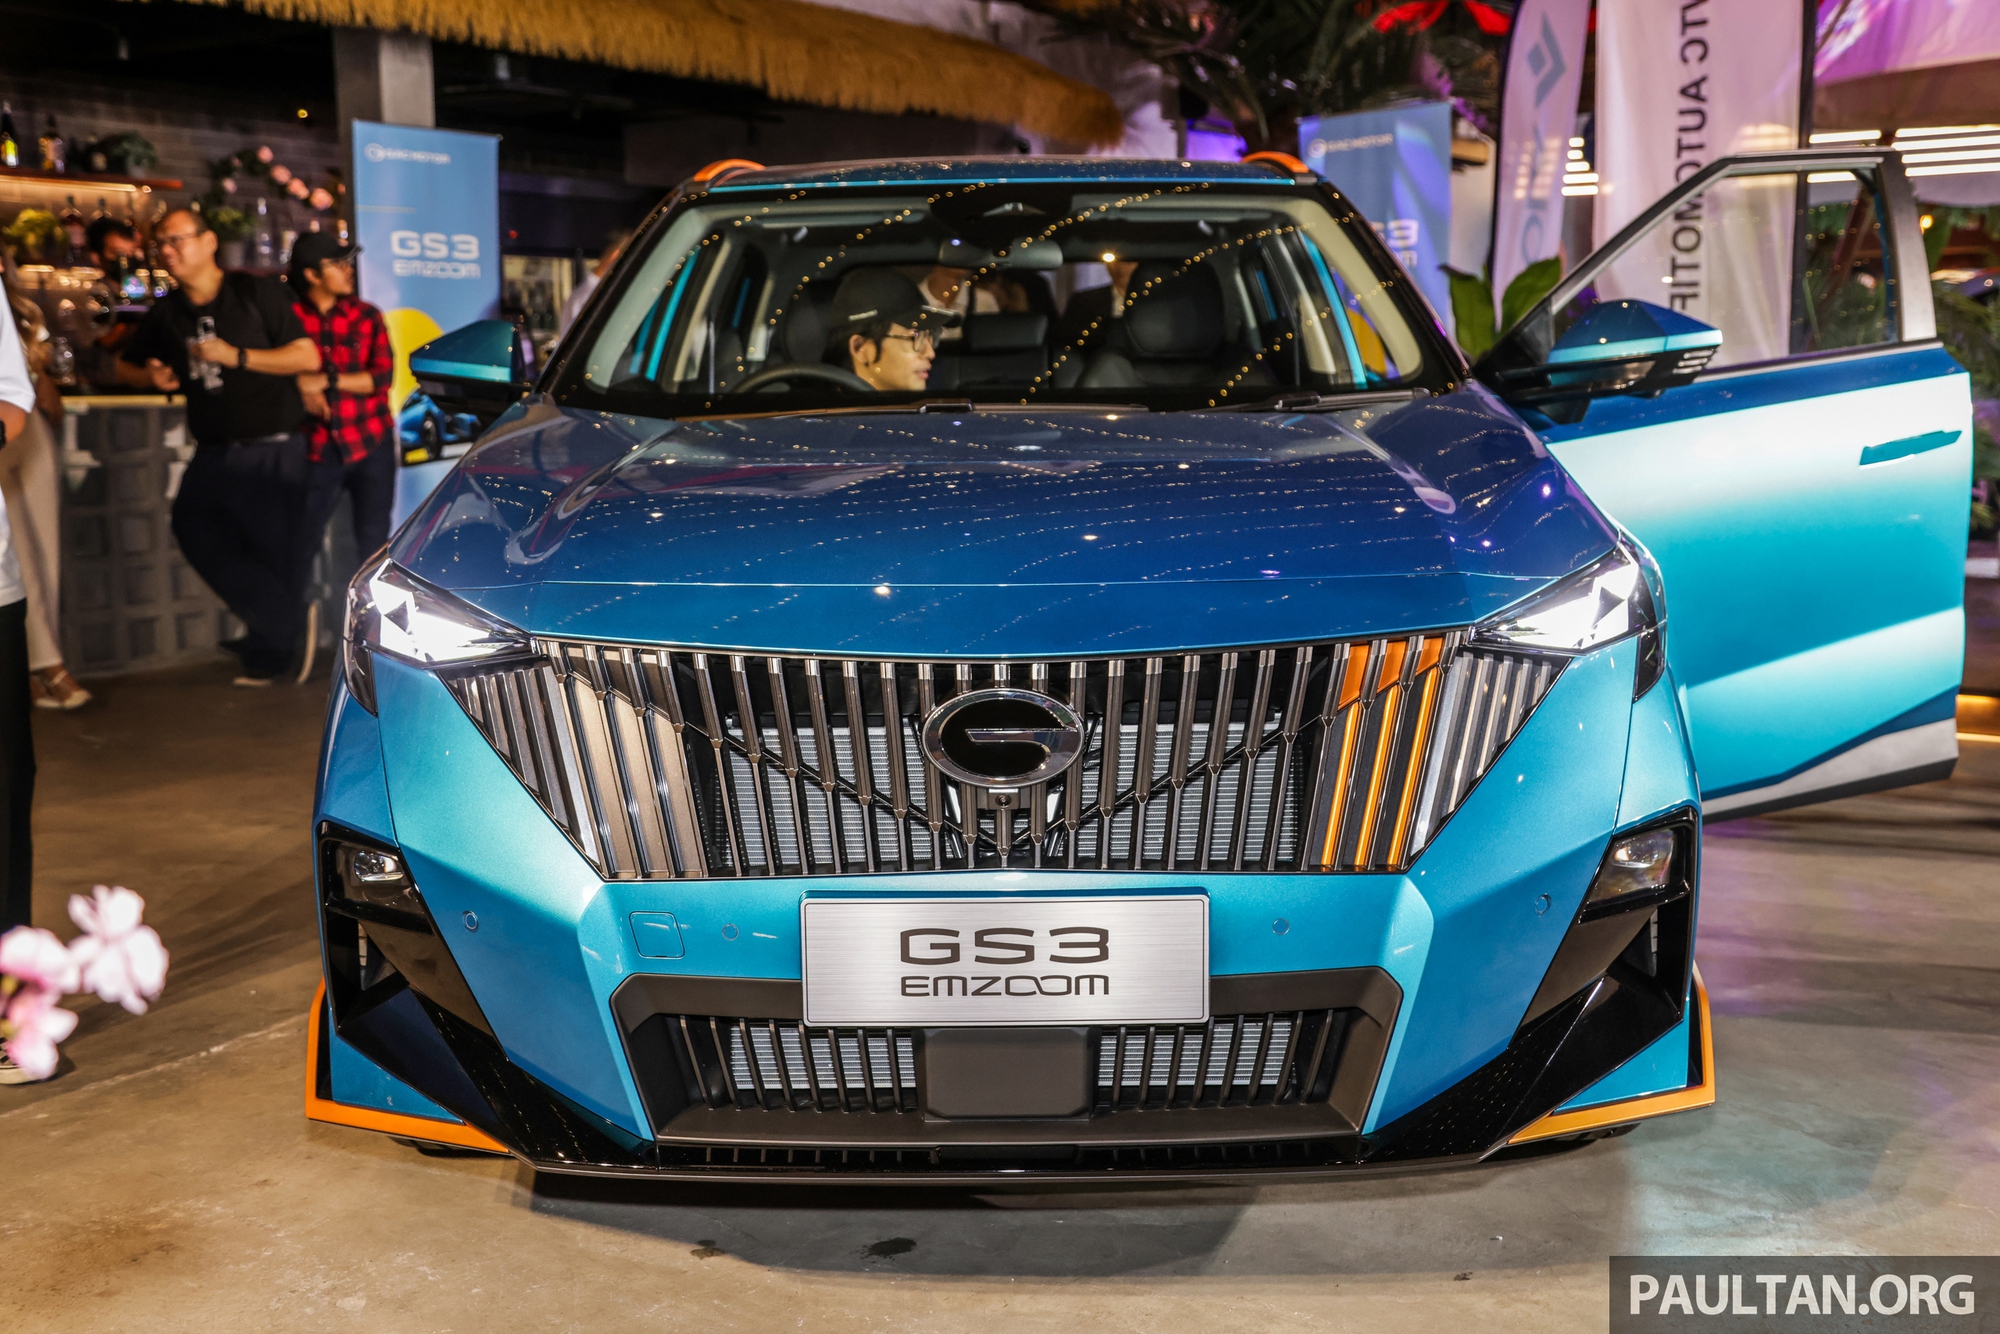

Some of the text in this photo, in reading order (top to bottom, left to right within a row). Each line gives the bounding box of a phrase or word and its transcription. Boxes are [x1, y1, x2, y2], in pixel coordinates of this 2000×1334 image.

[390, 230, 480, 261] GS3
[393, 259, 481, 280] EMZOOM
[900, 926, 1110, 966] GS3
[901, 974, 1110, 997] EMZOOM
